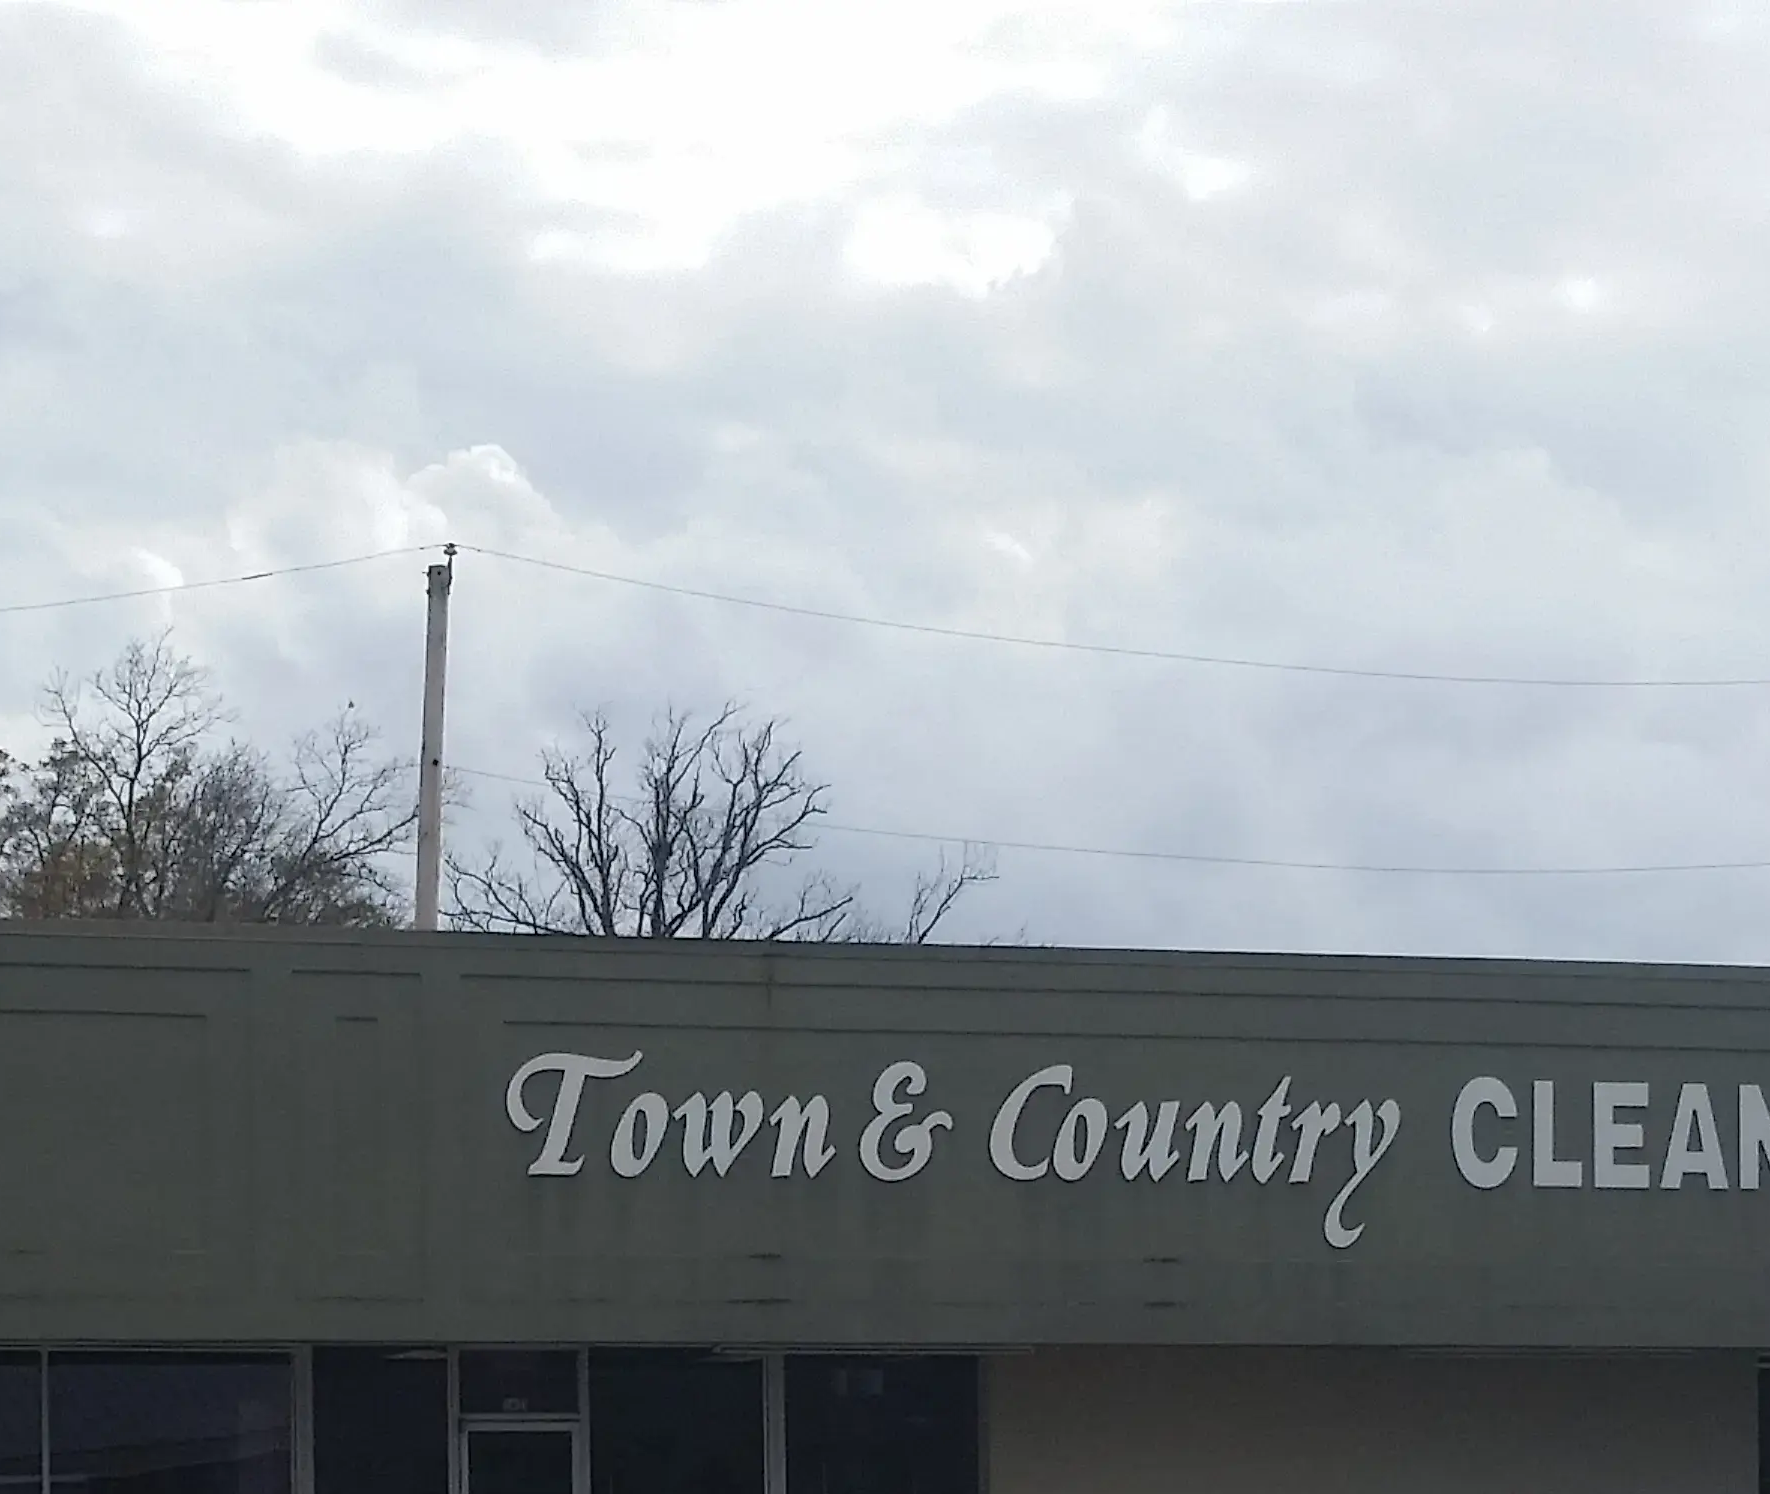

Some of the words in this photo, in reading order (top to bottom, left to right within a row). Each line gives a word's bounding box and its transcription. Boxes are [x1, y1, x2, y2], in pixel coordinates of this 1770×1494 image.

[506, 1050, 836, 1178] Town
[859, 1061, 953, 1182] &
[989, 1064, 1401, 1248] Country
